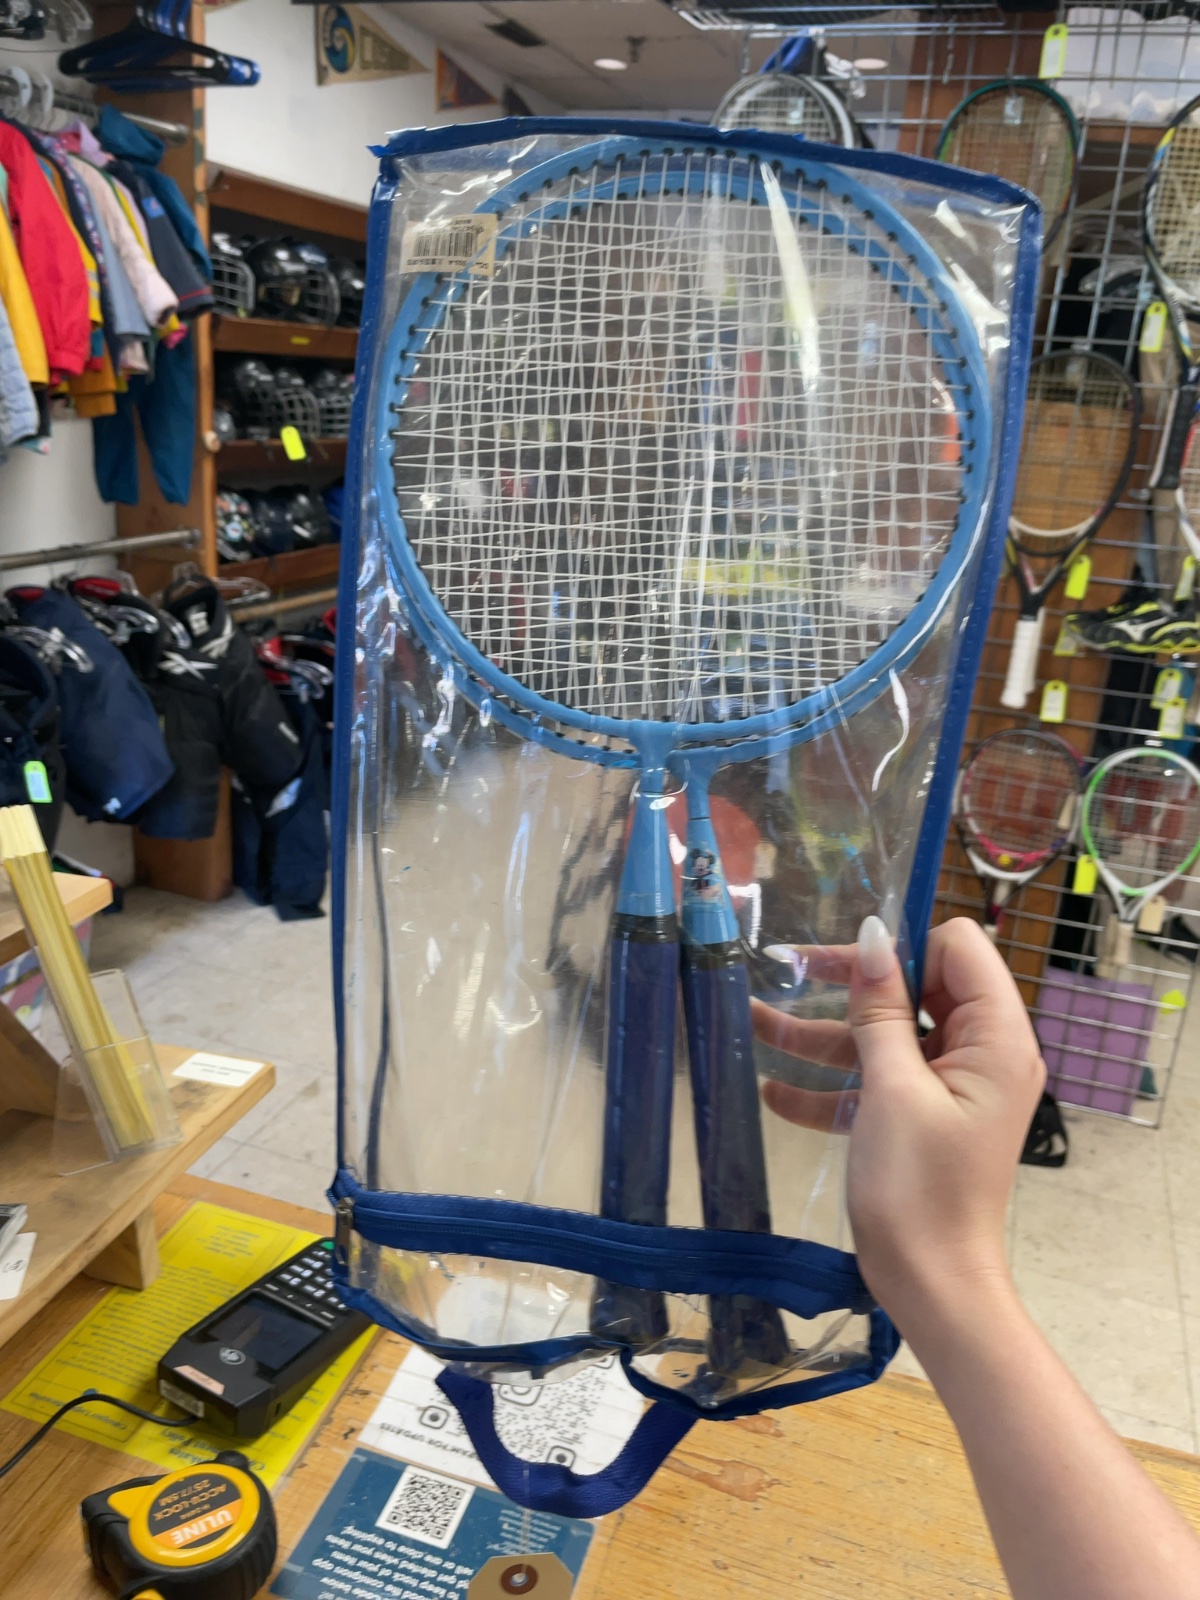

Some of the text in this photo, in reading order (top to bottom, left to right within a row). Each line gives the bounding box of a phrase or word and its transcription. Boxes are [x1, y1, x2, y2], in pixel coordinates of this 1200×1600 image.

[153, 1484, 227, 1521] ACCU-LOCK
[170, 1510, 232, 1545] ULINE
[325, 1534, 352, 1549] items
[384, 1541, 398, 1551] to
[351, 1543, 376, 1556] your
[397, 1545, 424, 1559] close
[312, 1558, 334, 1571] app
[330, 1550, 358, 1566] items
[424, 1554, 444, 1566] are
[356, 1560, 382, 1573] your
[442, 1560, 456, 1570] or
[454, 1565, 475, 1576] sell
[377, 1567, 393, 1577] of
[320, 1576, 353, 1594] below
[392, 1571, 419, 1587] track
[436, 1573, 458, 1585] get
[418, 1581, 447, 1598] keep
